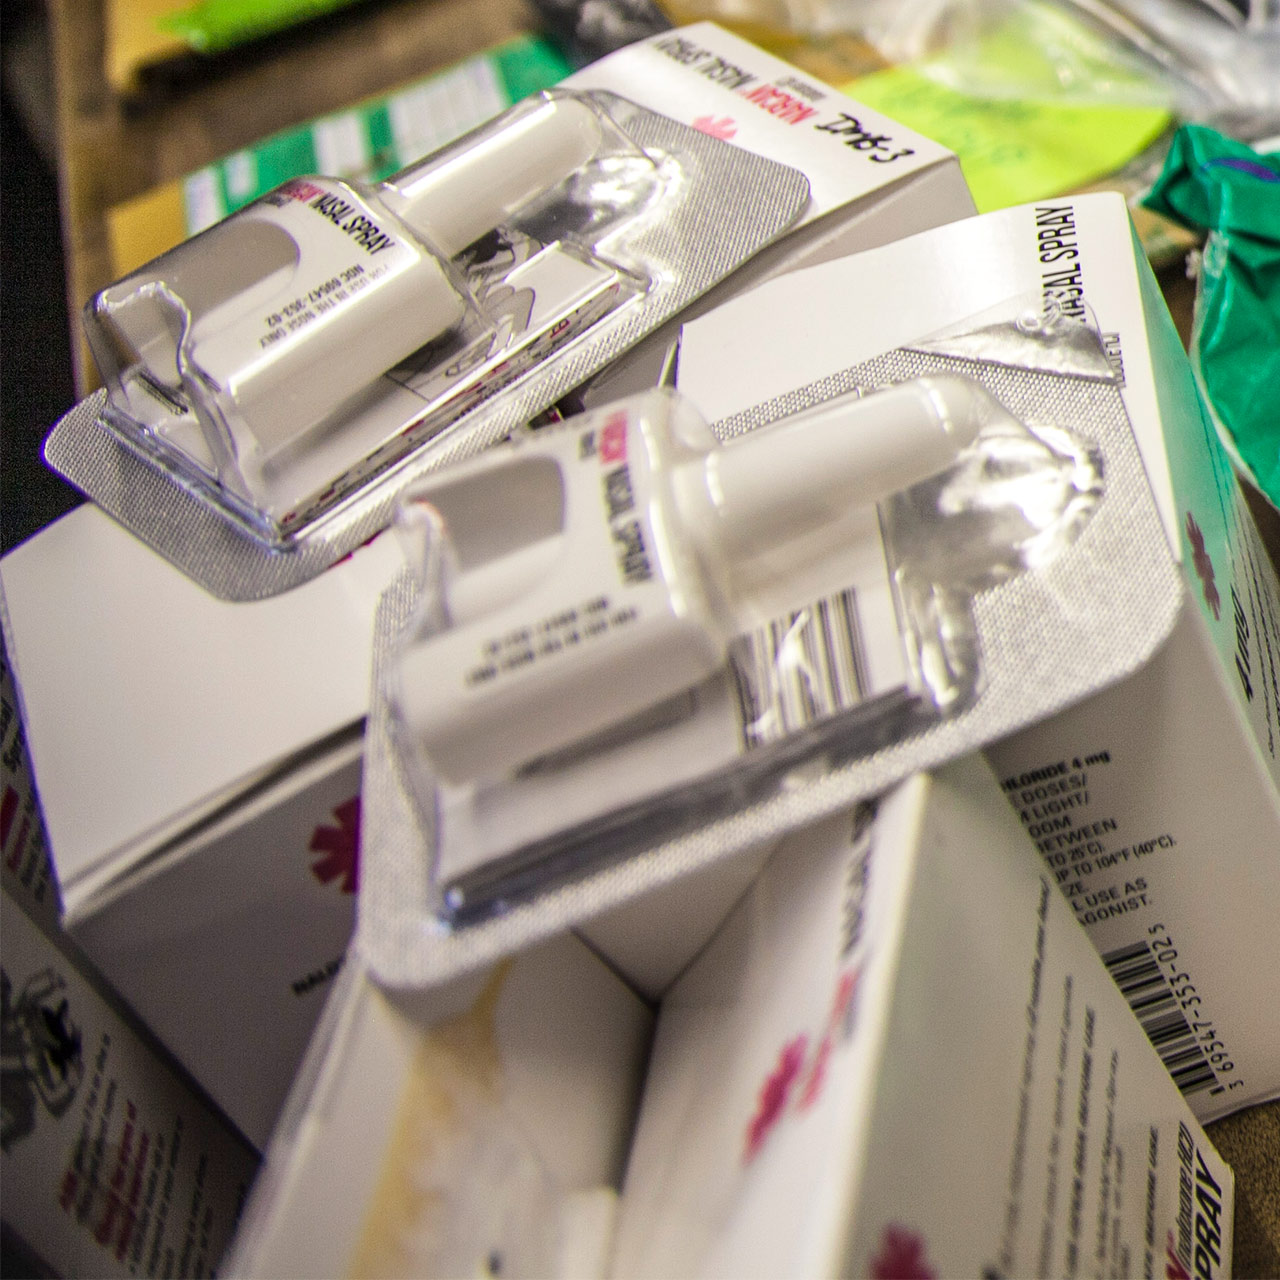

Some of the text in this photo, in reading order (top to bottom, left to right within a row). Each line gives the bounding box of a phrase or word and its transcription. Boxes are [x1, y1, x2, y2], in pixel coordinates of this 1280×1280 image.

[343, 215, 396, 256] SPRAY
[1034, 205, 1080, 263] SPRAY
[1072, 757, 1083, 770] 4
[1084, 750, 1111, 766] mg
[1074, 862, 1092, 877] TO
[1085, 886, 1120, 908] USE
[1124, 877, 1148, 896] AS
[1194, 1145, 1223, 1280] PRAY
